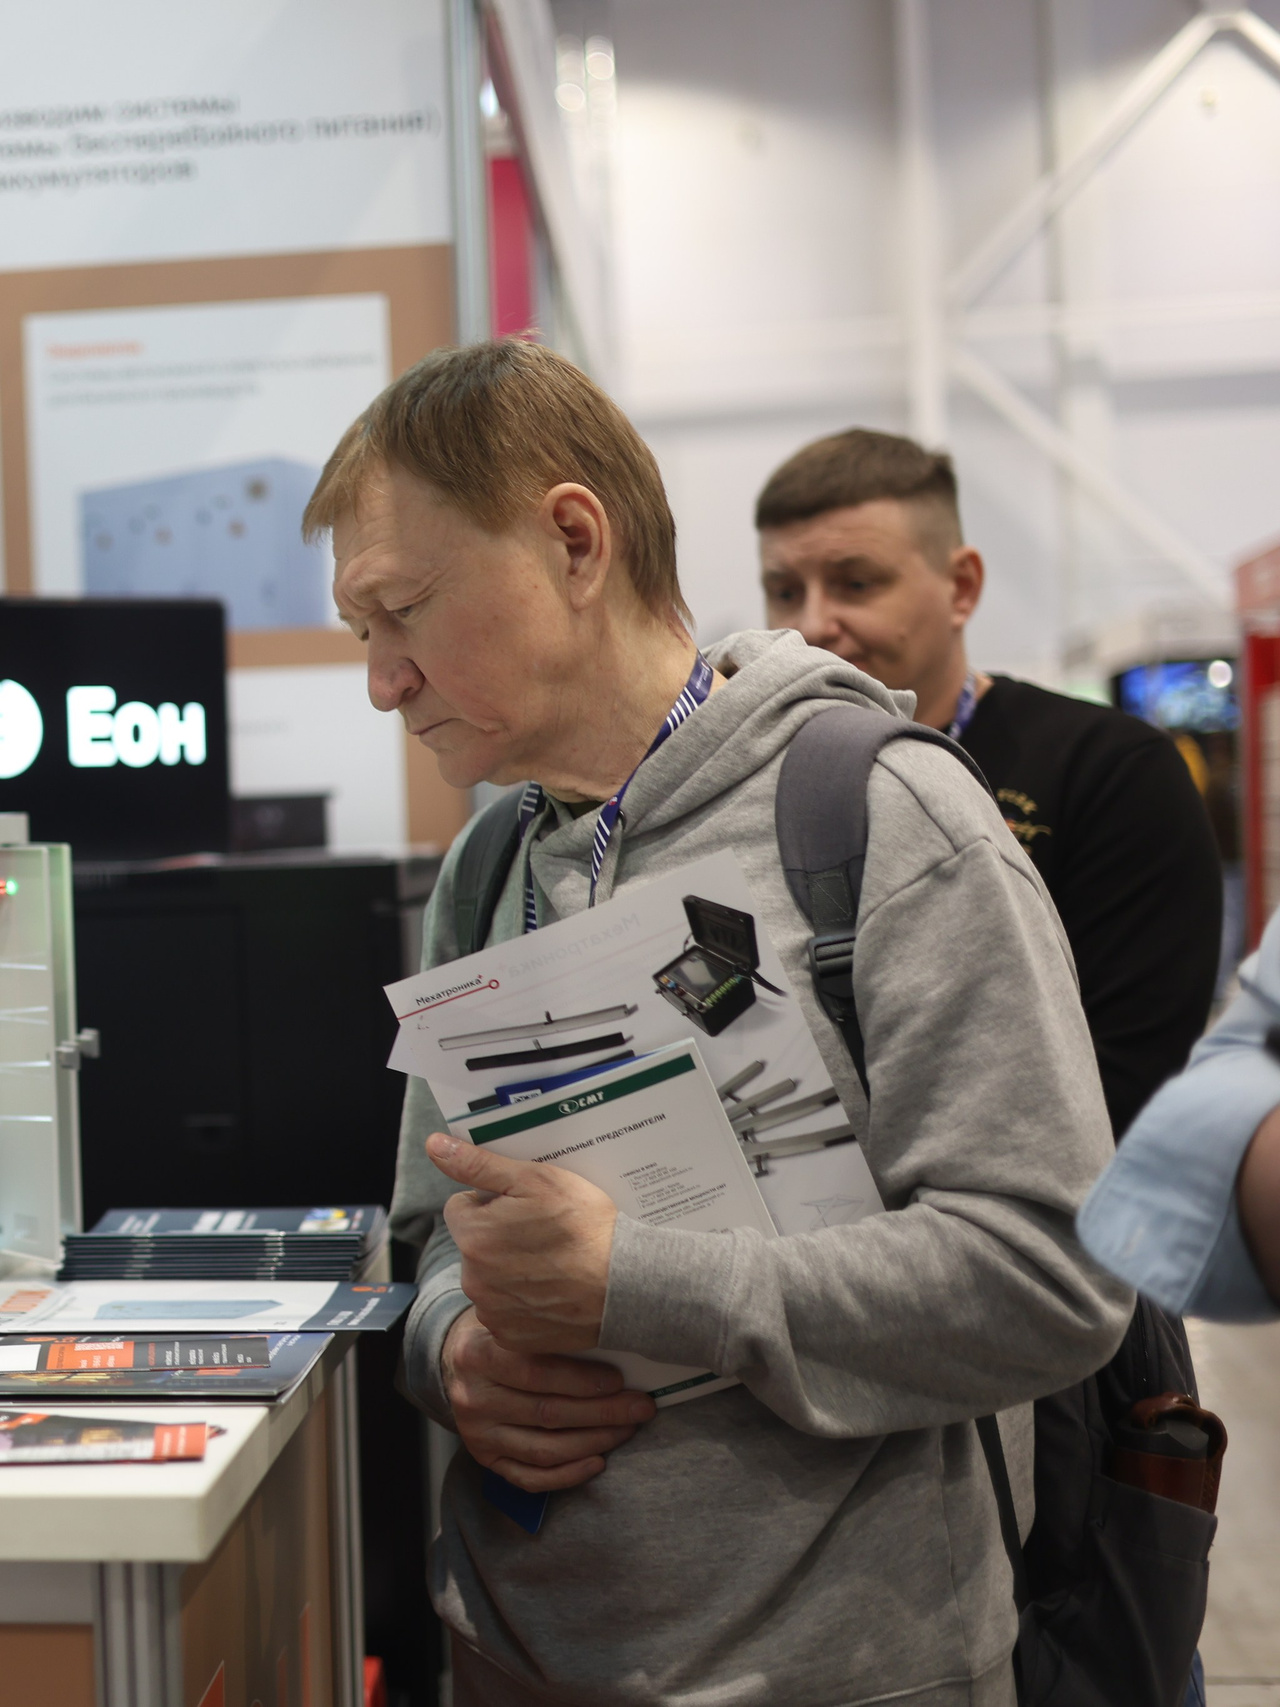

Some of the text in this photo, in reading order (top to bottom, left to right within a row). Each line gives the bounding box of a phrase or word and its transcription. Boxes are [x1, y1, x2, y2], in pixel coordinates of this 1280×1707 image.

[65, 684, 207, 769] Еон
[415, 977, 482, 1006] Мехатроника
[595, 1112, 667, 1144] ПРЕДСТАВИТЕЛИ
